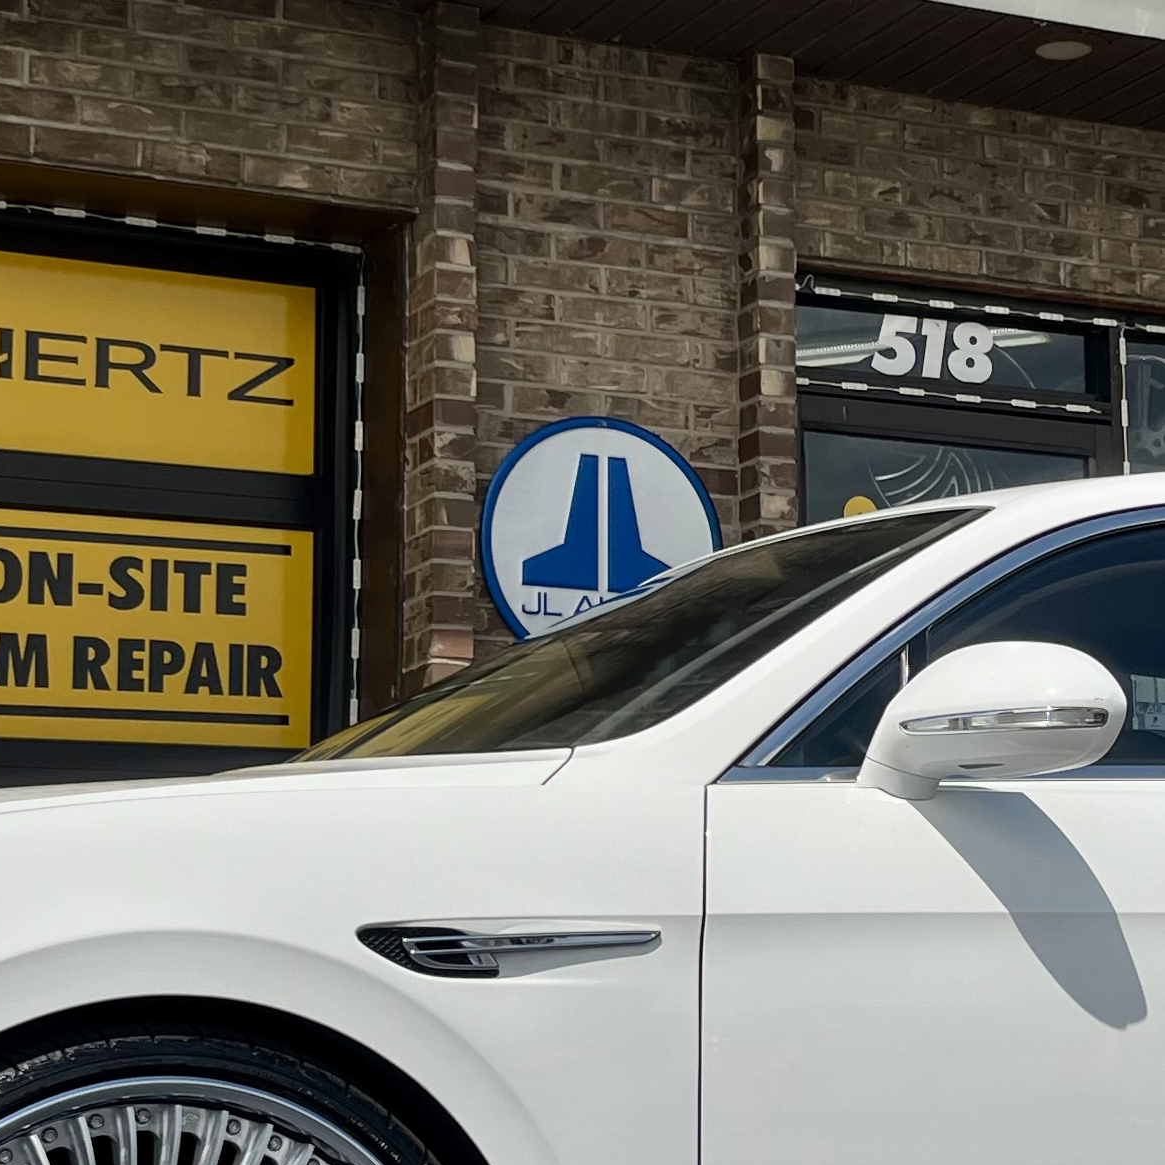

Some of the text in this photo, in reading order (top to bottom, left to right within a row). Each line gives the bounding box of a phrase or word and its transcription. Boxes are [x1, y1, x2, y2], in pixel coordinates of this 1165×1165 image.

[870, 313, 994, 384] 518
[521, 591, 563, 617] JL
[71, 635, 284, 699] REPAIR
